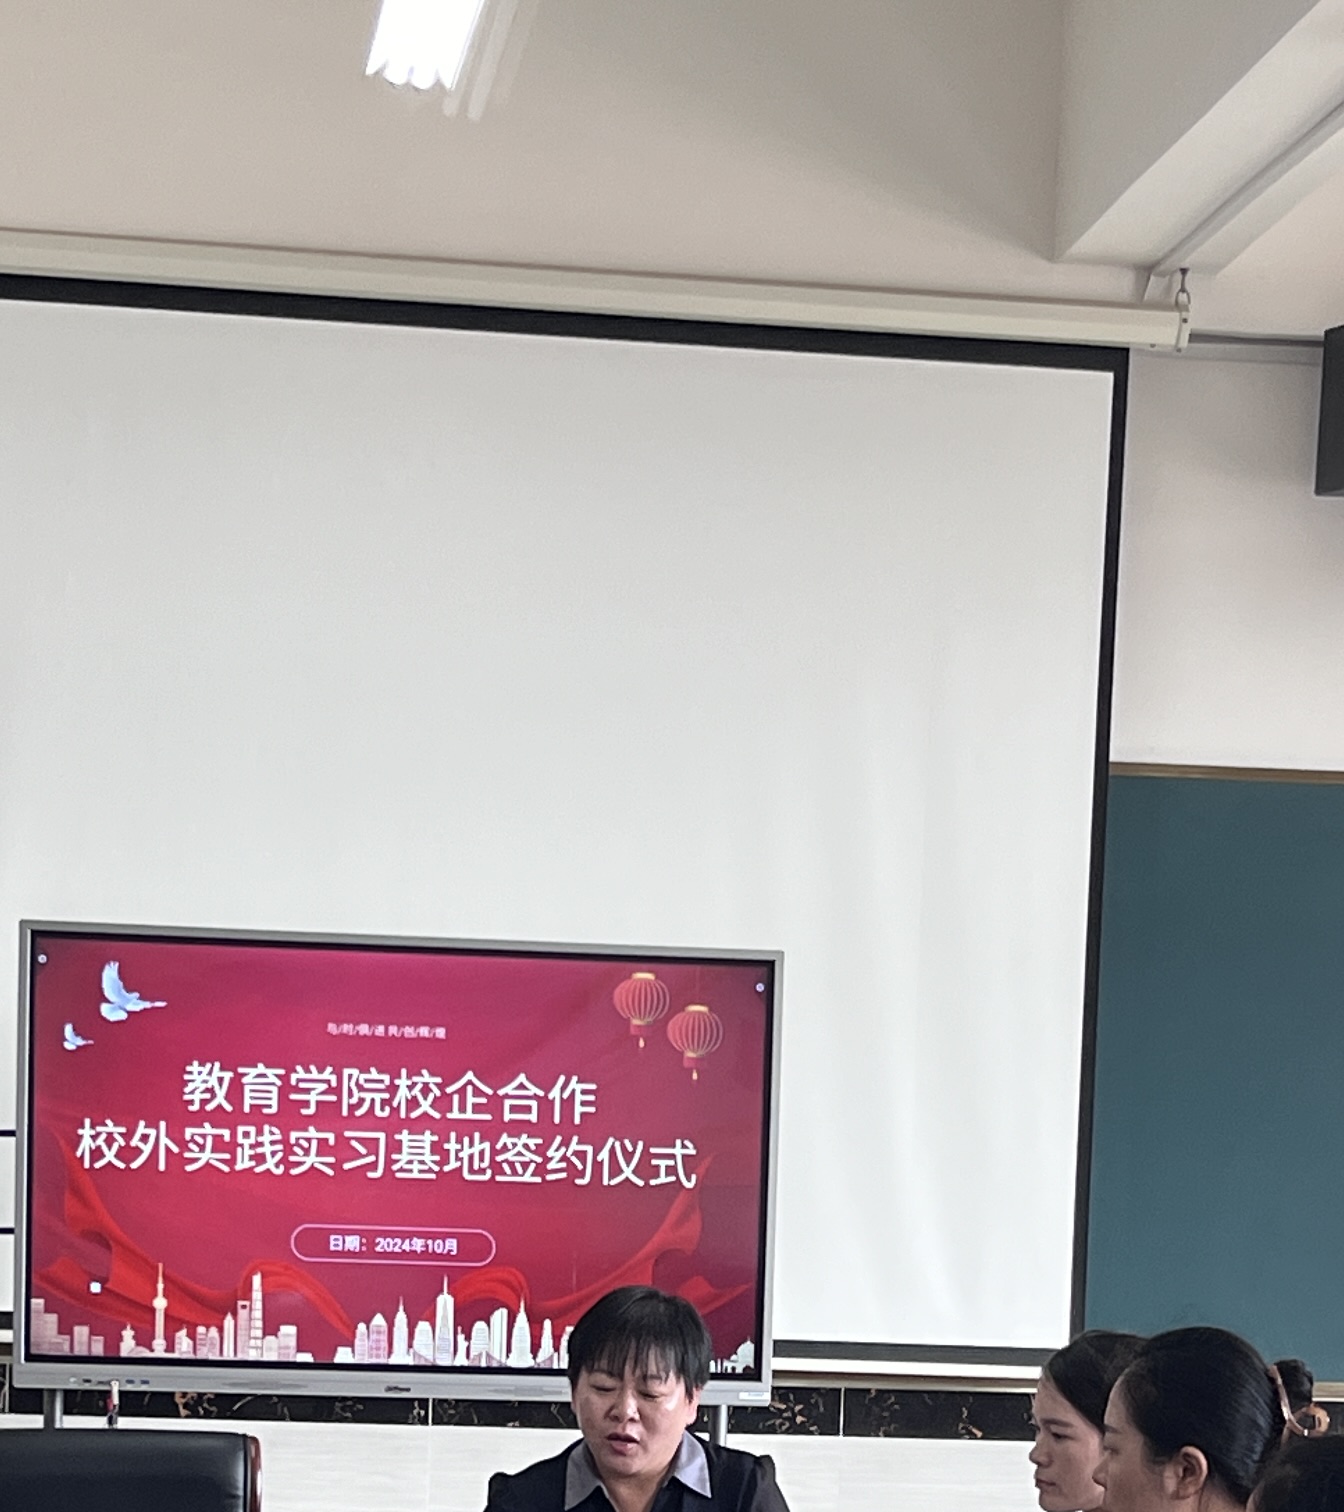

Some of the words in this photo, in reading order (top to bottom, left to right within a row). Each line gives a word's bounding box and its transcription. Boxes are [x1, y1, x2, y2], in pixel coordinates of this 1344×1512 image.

[181, 1060, 599, 1125] 教育学院校企合作
[76, 1117, 699, 1190] 校外实践实习基地签约仪式
